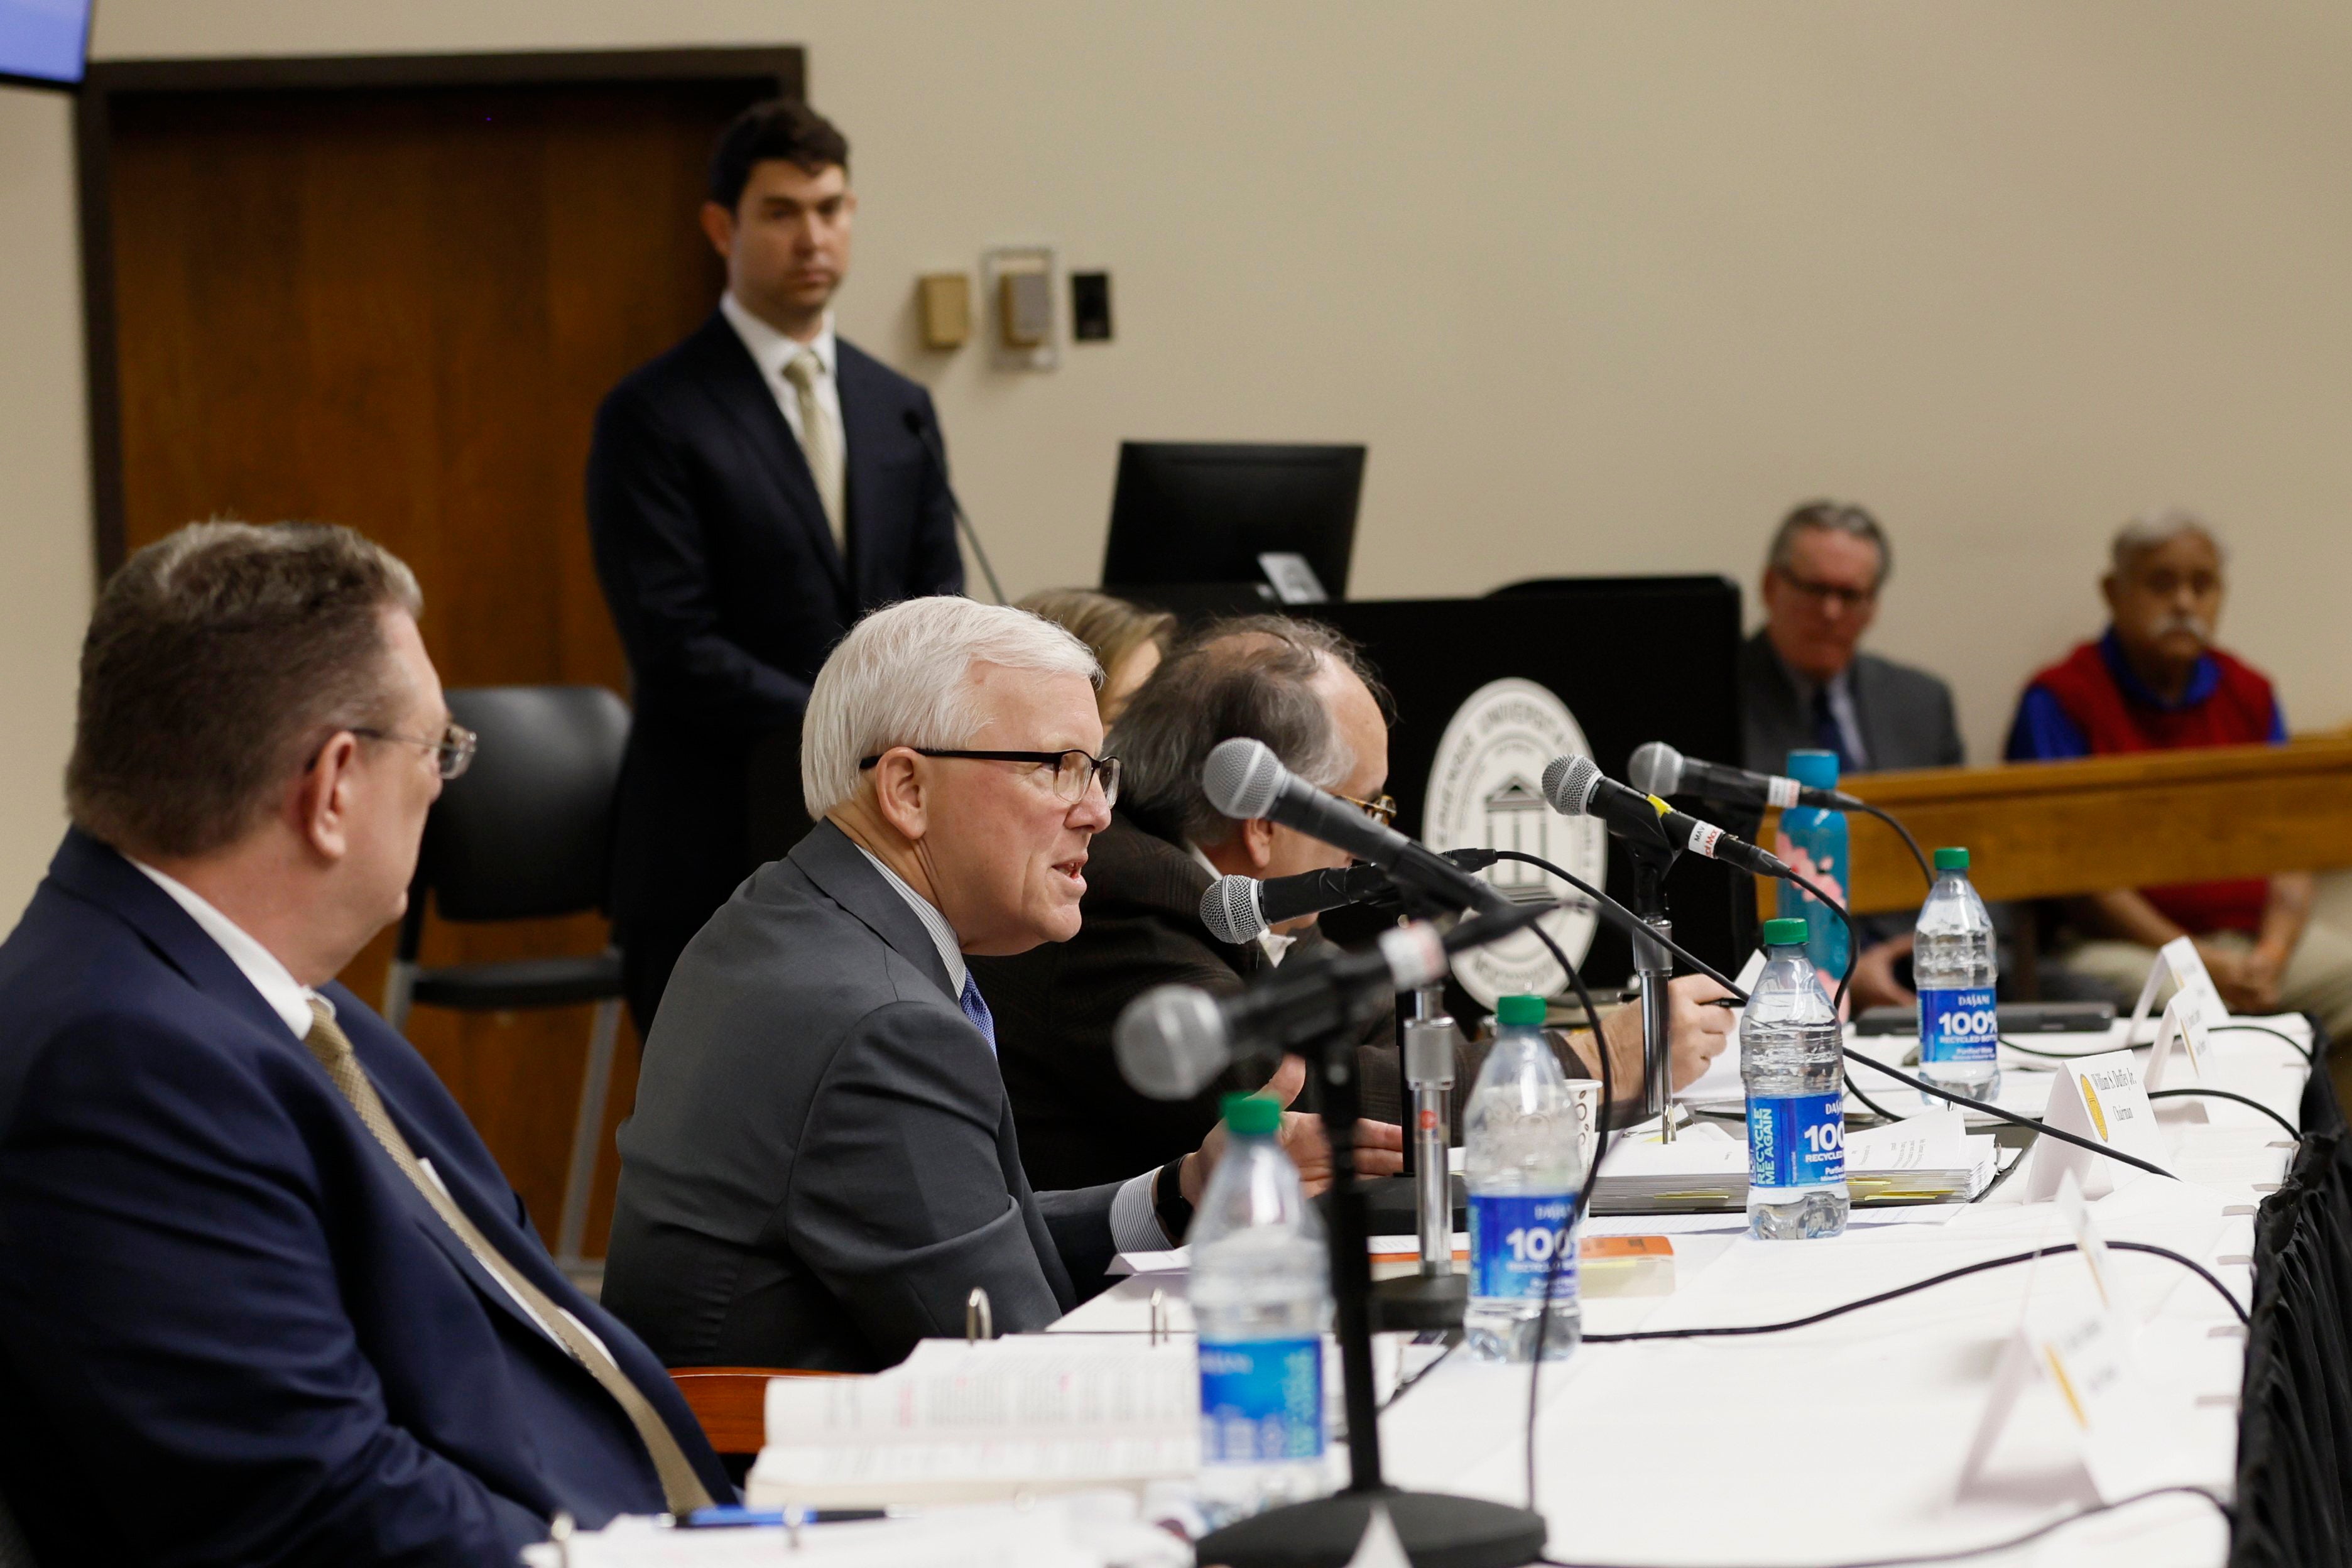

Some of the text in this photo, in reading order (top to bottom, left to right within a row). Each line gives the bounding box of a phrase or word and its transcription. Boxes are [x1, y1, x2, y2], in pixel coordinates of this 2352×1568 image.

[1754, 1108, 1766, 1184] RECYCLE
[1762, 1108, 1776, 1185] ME AGAIN
